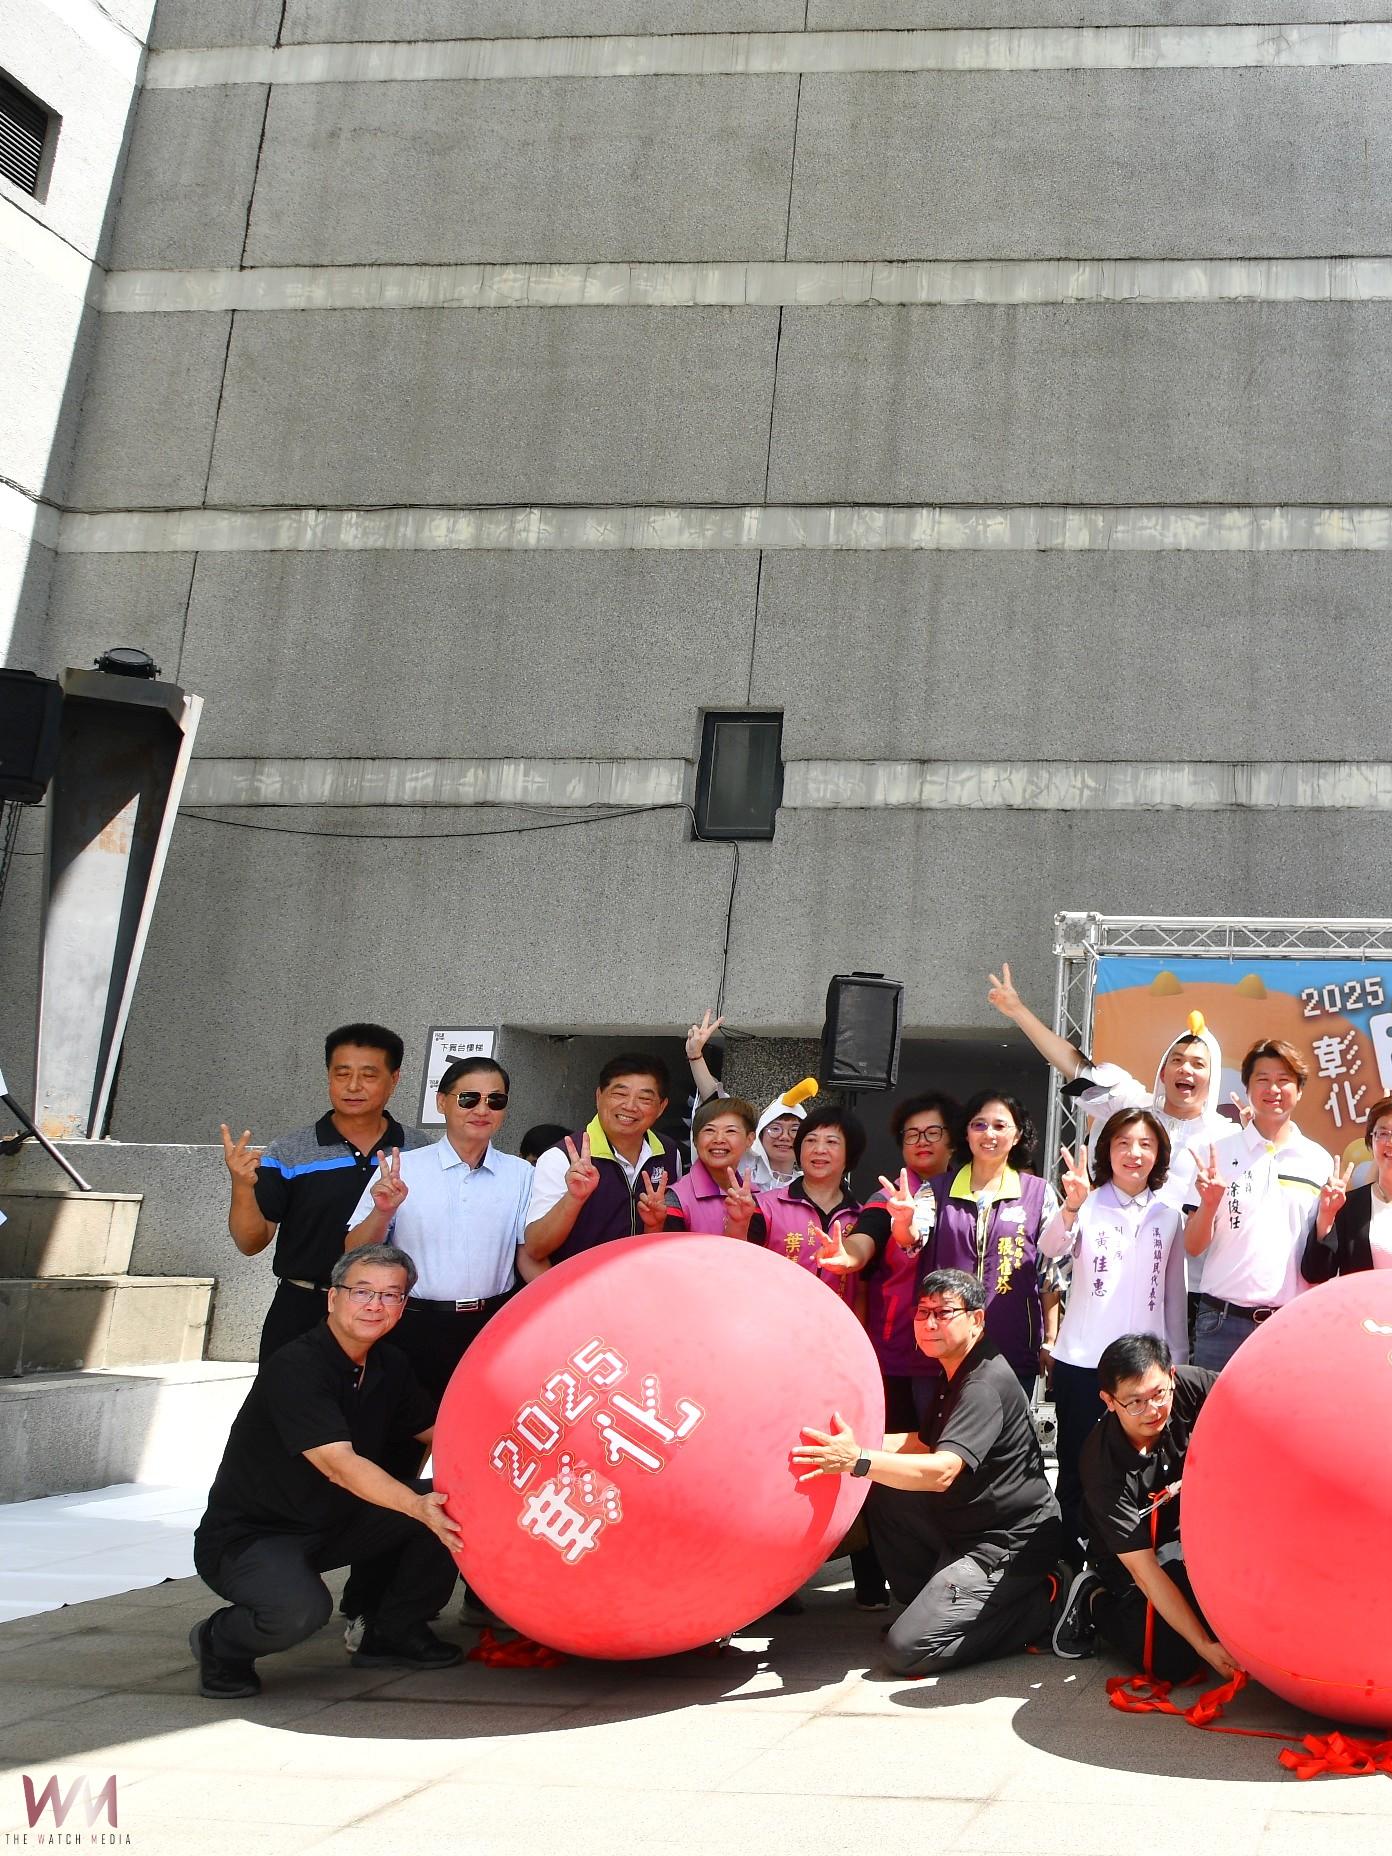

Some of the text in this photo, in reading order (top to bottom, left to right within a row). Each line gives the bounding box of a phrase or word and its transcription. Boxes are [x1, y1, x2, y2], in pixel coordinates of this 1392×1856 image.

[1301, 976, 1385, 1017] 2025
[1312, 1030, 1371, 1128] 彰化
[491, 1339, 626, 1490] 2025
